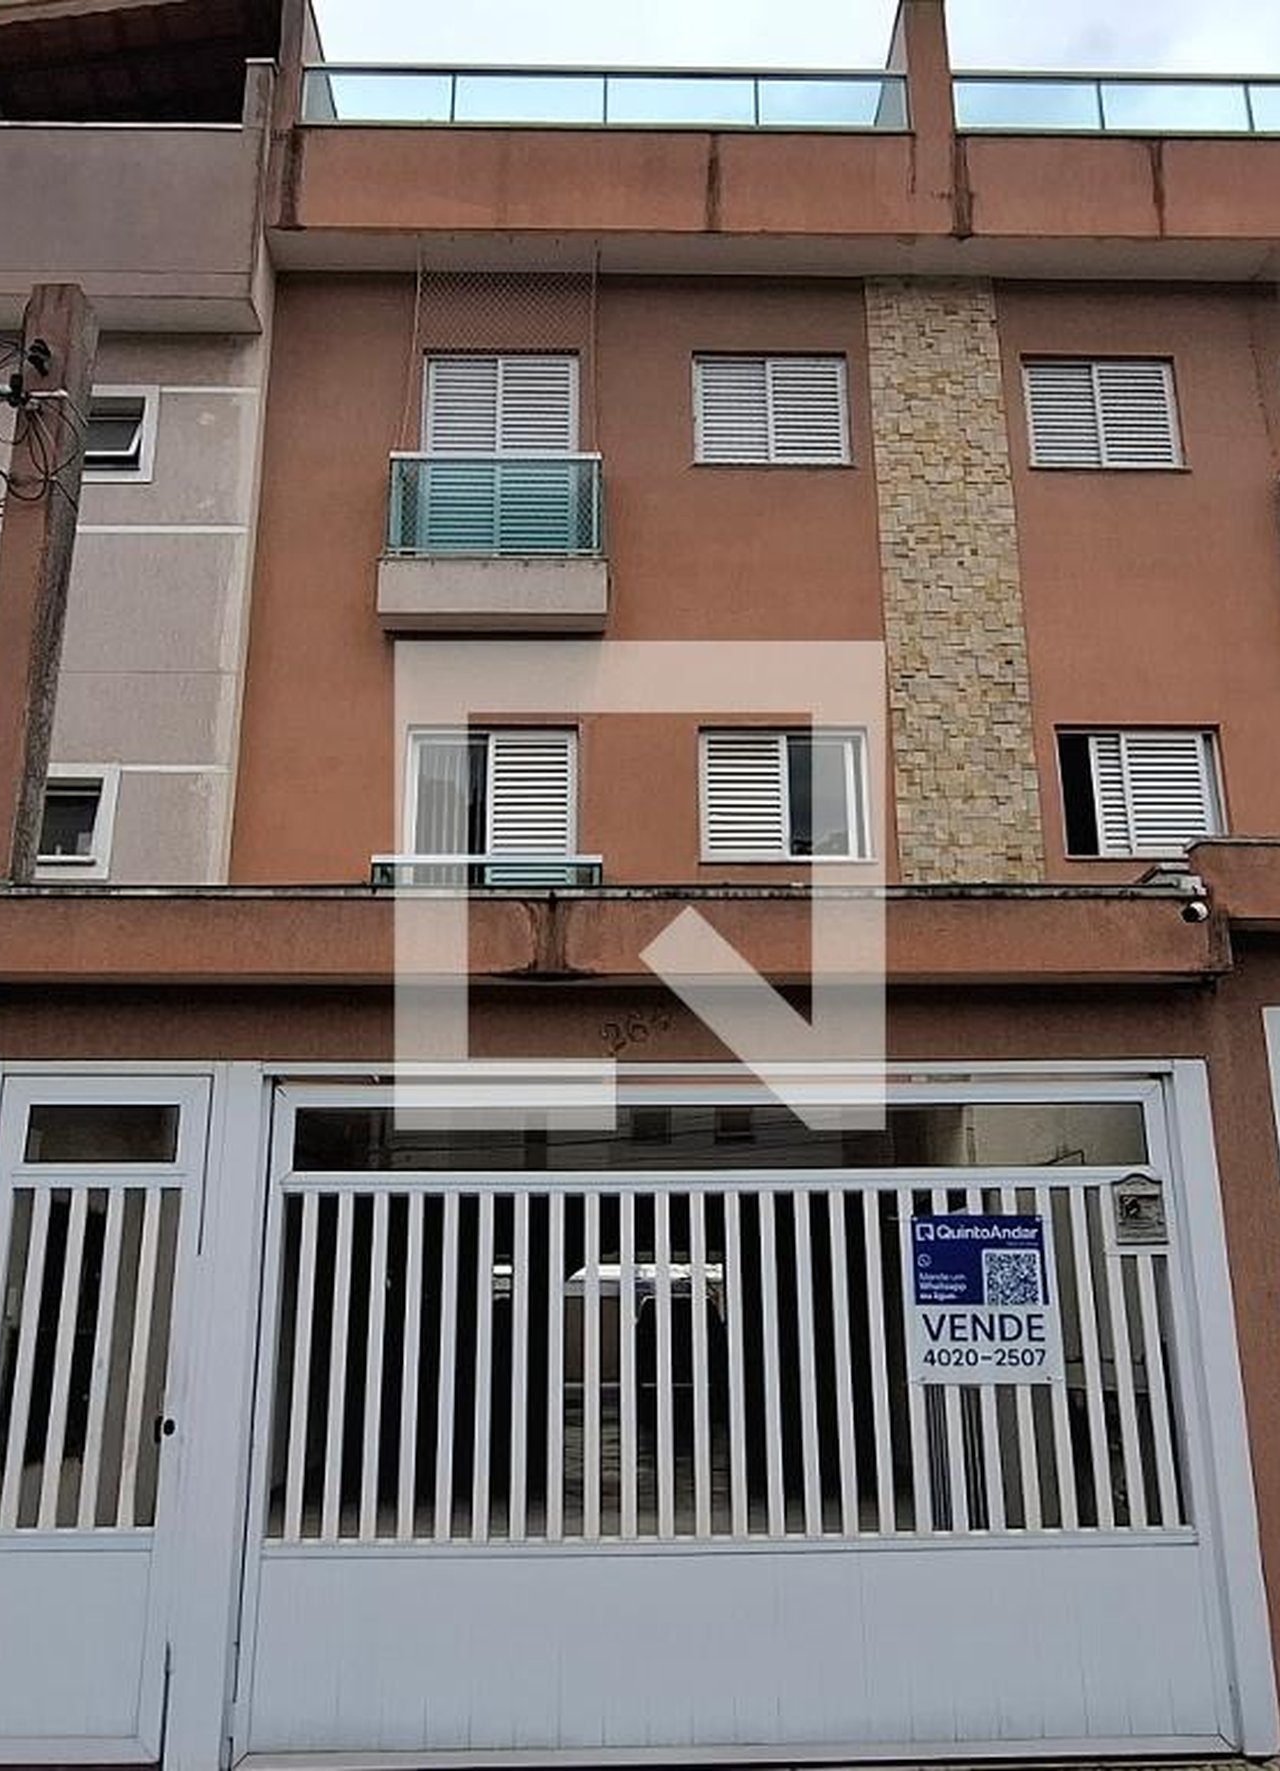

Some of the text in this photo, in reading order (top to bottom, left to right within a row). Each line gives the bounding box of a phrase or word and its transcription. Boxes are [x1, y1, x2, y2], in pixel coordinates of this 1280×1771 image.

[936, 1224, 1039, 1241] QuintoAndar
[922, 1313, 1046, 1342] VENDE
[923, 1348, 1047, 1367] 4020-2507
